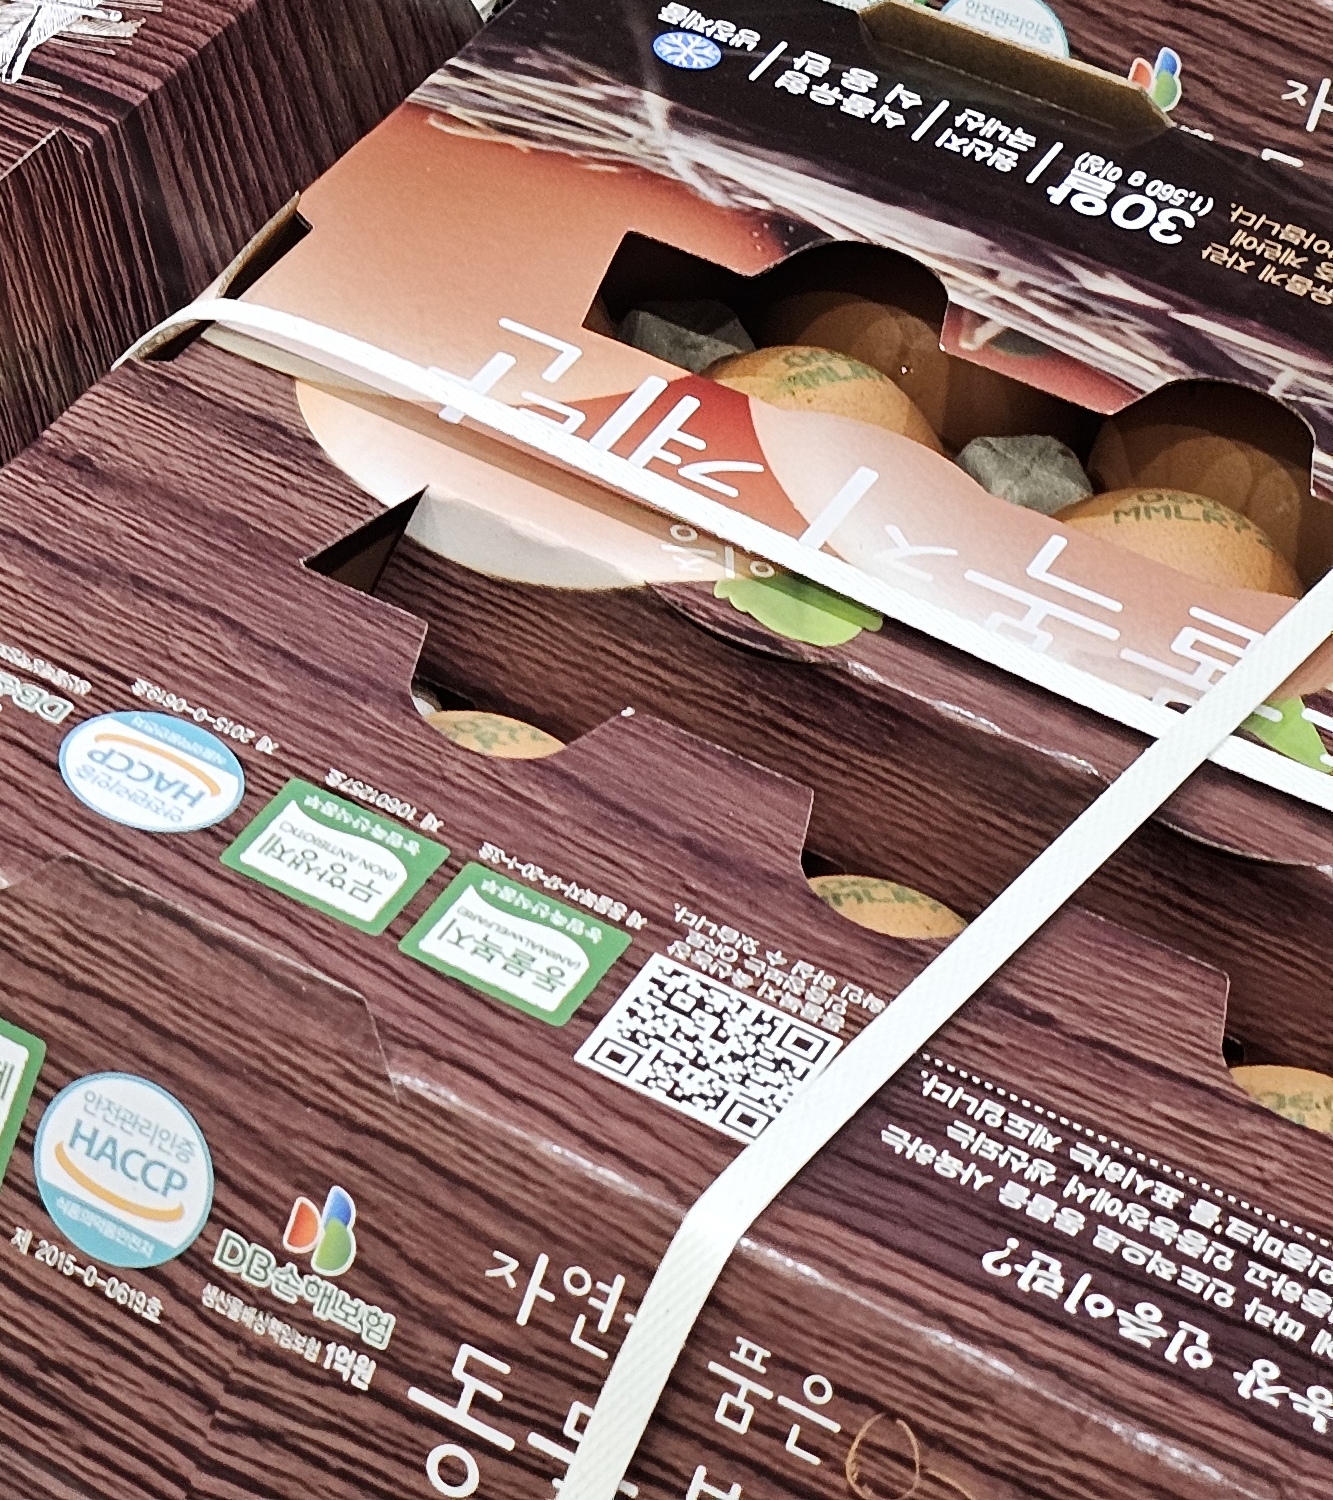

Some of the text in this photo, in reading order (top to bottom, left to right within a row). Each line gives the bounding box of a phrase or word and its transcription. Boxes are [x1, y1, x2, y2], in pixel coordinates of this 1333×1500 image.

[658, 2, 760, 50] 냉장제품
[775, 66, 904, 127] 식품유형
[954, 108, 1035, 151] 국내산
[935, 128, 1018, 171] 원산지
[1073, 152, 1122, 185] 이상)
[1047, 166, 1194, 243] 30알
[1145, 179, 1213, 216] (1,560
[1201, 242, 1255, 273] 자란
[1229, 229, 1307, 268] 계란에
[425, 317, 764, 499] 계란
[87, 748, 204, 807] HACCP
[258, 833, 380, 902] 무항생제
[437, 918, 565, 992] 동물복지
[674, 903, 759, 955] 있습니다.
[764, 948, 788, 970] 수
[83, 1090, 200, 1163] 안전관리인증
[921, 1071, 1061, 1151] 제도입니다.
[69, 1119, 187, 1196] HACCP
[1069, 1142, 1183, 1208] 표시하는
[881, 1124, 1305, 1341] 따라 인도적으로 동물을 사육하는
[946, 1120, 1333, 1319] 증하고 인증농장에서 생산되는
[10, 1226, 162, 1323] 제 2015-0-0619호
[214, 1230, 394, 1348] DB손해보험
[983, 1239, 1211, 1368] 인증이란?
[323, 1342, 376, 1390] 1억원
[485, 1251, 637, 1361] 자연
[707, 1334, 843, 1467] 품은
